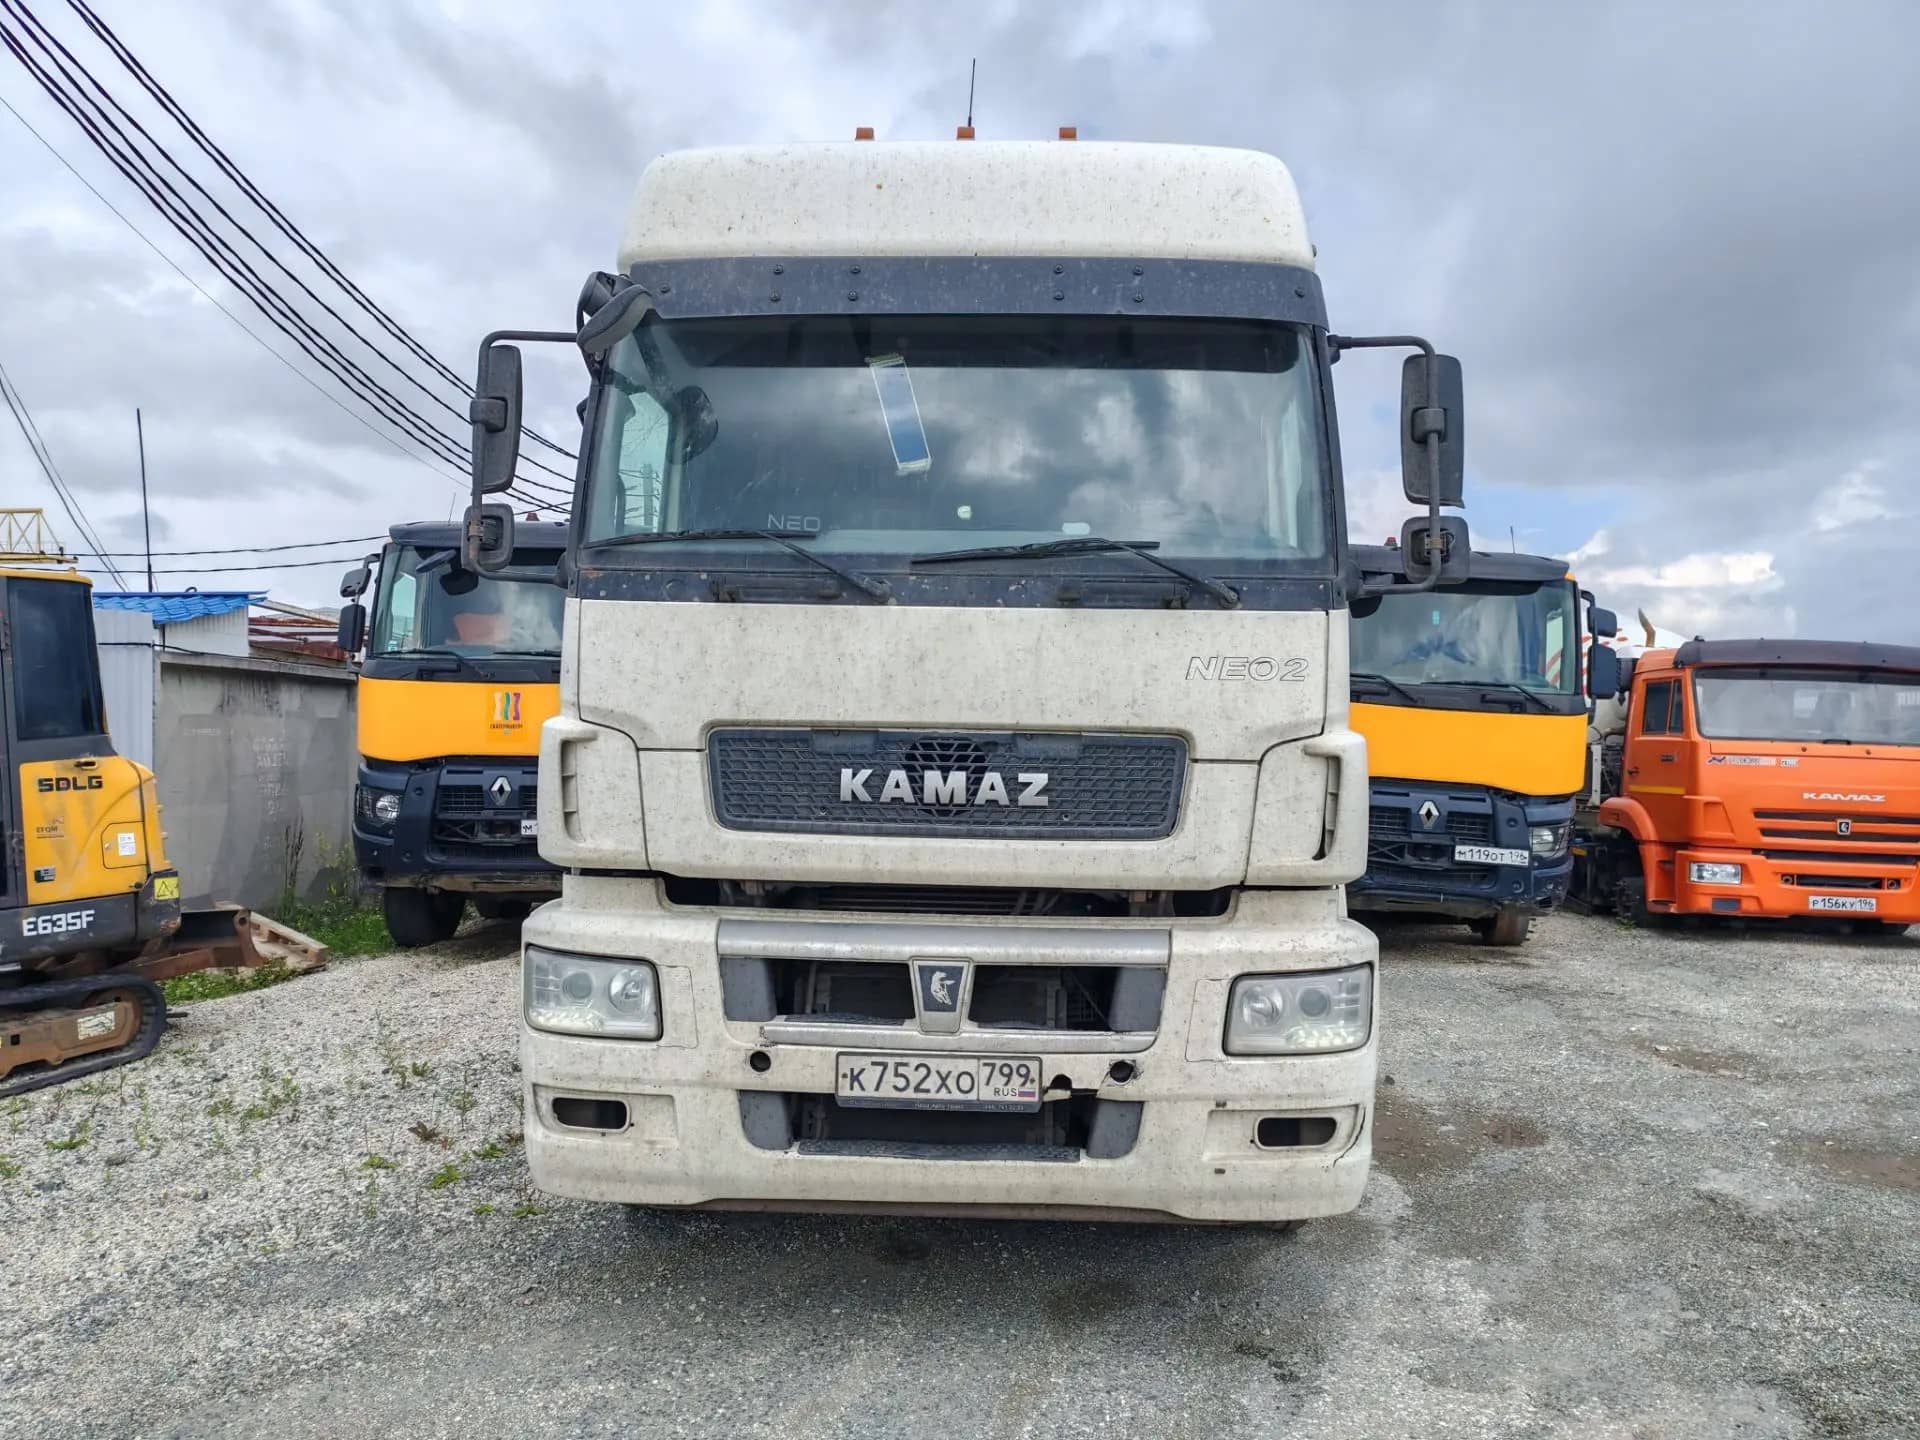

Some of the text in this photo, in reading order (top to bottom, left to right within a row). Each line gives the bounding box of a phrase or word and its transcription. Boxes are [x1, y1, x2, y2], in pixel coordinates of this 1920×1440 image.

[767, 513, 820, 532] NEO
[1185, 656, 1309, 681] NEO2
[37, 776, 103, 792] SDLG
[840, 768, 1049, 806] KAMAZ
[1802, 792, 1886, 802] KAMAZ
[22, 909, 95, 936] E635F
[850, 1061, 1031, 1095] К752ХО 799
[994, 1087, 1017, 1097] RUS
